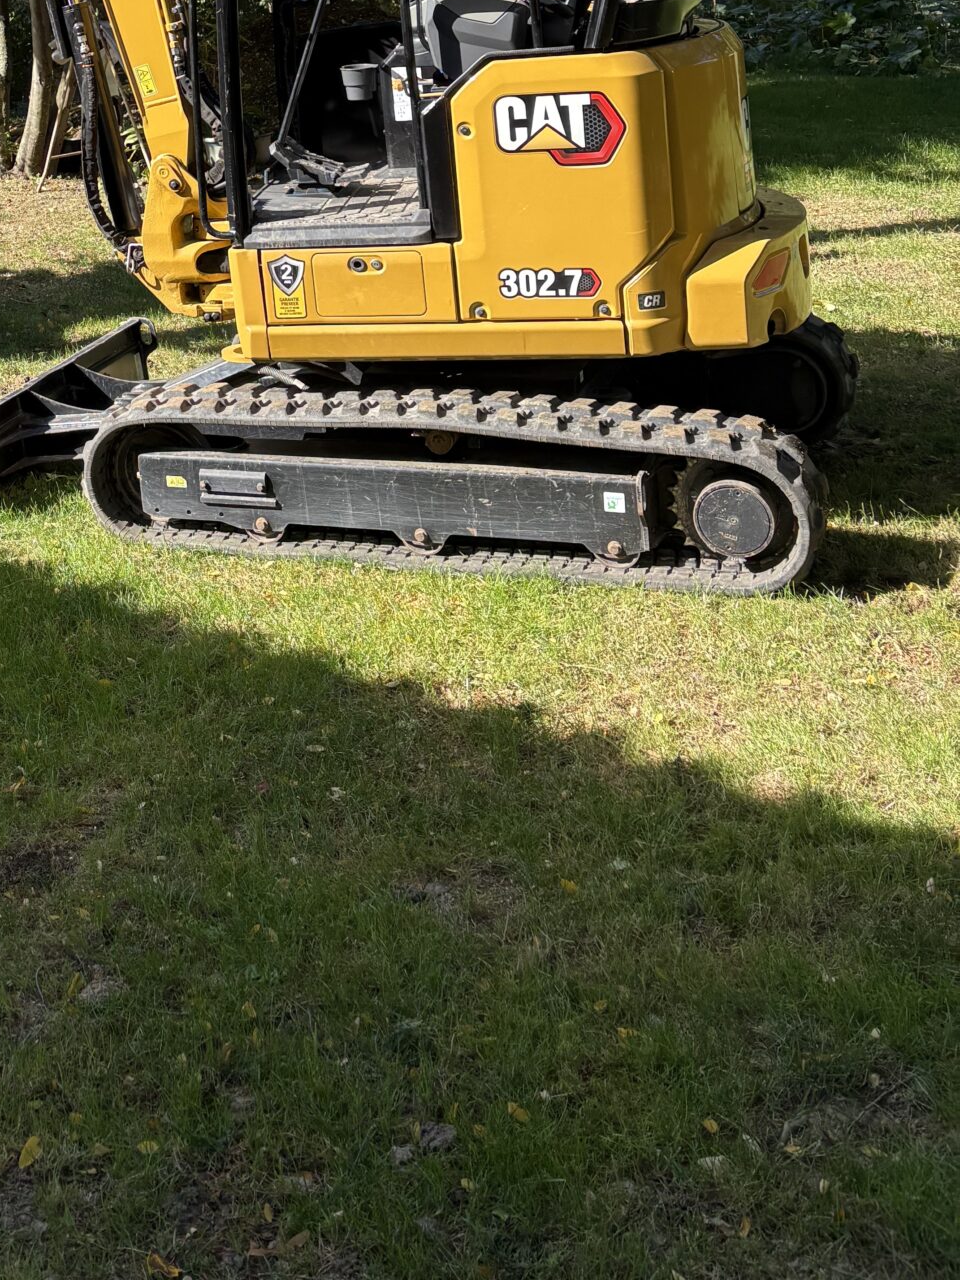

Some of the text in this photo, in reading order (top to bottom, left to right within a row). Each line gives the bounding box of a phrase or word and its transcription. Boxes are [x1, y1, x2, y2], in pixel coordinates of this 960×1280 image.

[495, 93, 591, 151] CAT
[280, 264, 293, 280] 2
[499, 269, 582, 297] 302.7
[643, 294, 661, 308] CR
